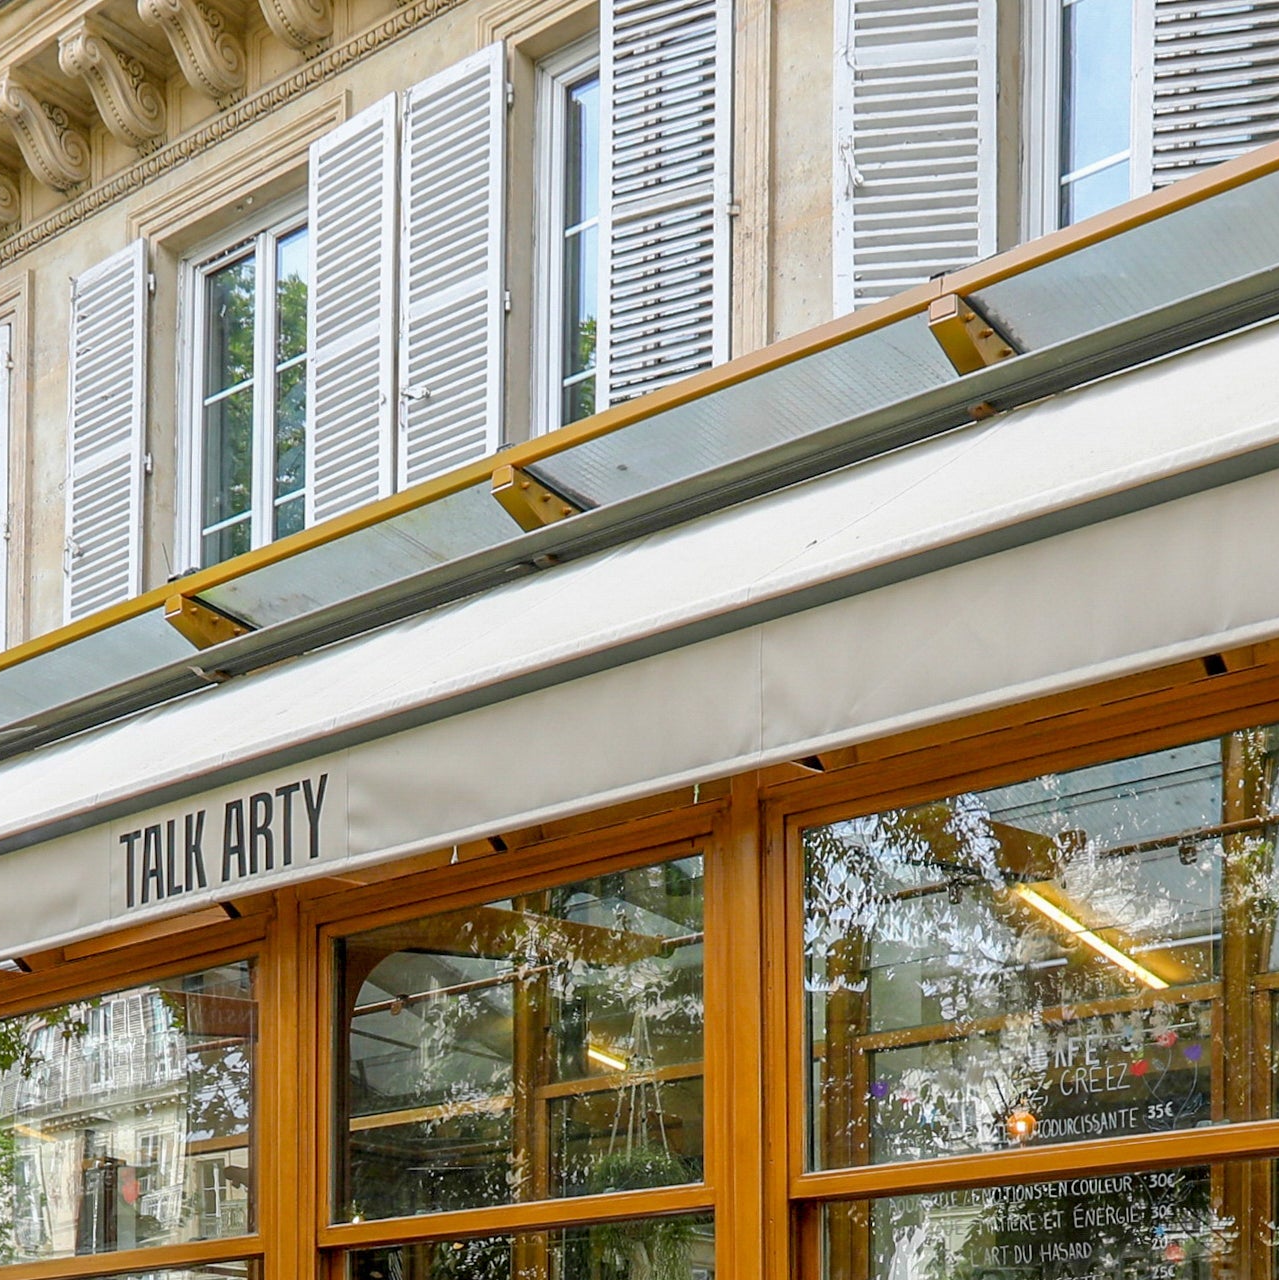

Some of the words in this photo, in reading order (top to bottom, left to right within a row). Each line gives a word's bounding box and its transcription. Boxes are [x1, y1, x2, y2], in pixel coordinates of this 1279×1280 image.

[119, 809, 207, 909] TALK
[221, 773, 328, 882] ARTY
[1147, 1101, 1174, 1119] 35€
[1047, 1182, 1067, 1198] EN
[1071, 1175, 1132, 1196] COULEUR
[1148, 1173, 1176, 1188] 30€
[1044, 1210, 1065, 1231] ET
[1151, 1203, 1175, 1219] 30€
[1014, 1243, 1033, 1264] DU
[1040, 1242, 1092, 1263] HASARD
[1152, 1266, 1176, 1280] 25€
